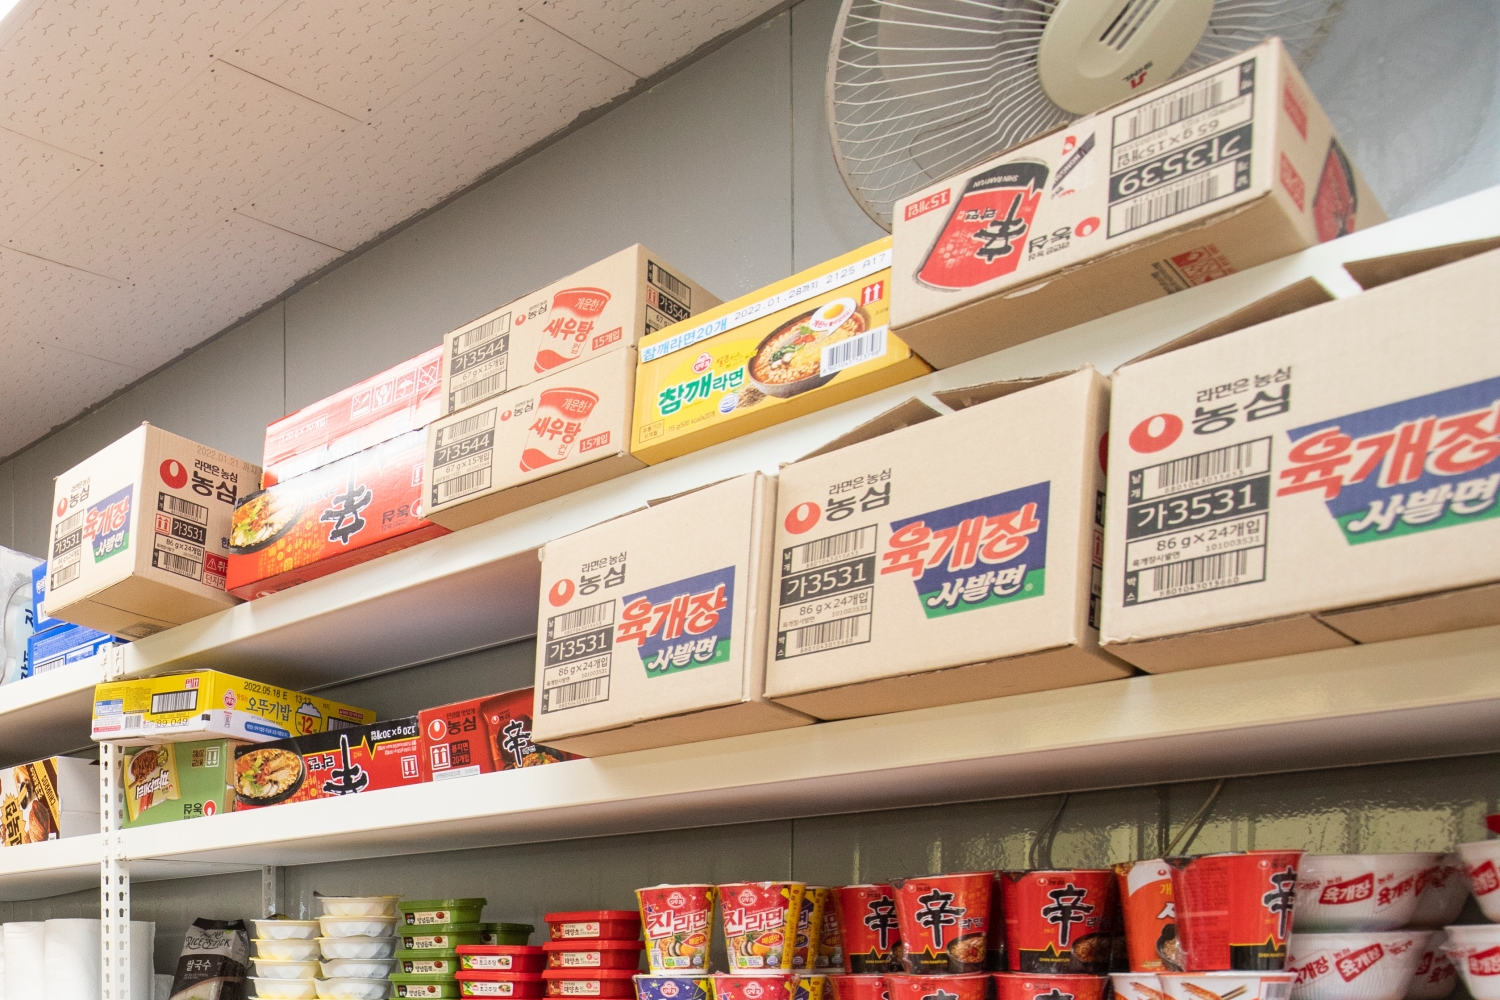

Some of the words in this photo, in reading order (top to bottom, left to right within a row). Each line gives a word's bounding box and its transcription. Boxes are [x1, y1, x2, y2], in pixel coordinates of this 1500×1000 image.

[1119, 134, 1240, 193] 가3539
[826, 264, 855, 284] 2125
[863, 252, 886, 270] A17
[545, 316, 594, 342] 새우탕
[593, 327, 622, 349] 15개입
[455, 339, 505, 369] 가3544
[658, 367, 744, 415] 참깨라면
[1196, 378, 1251, 403] 라면은
[1192, 383, 1291, 435] 농심
[531, 416, 582, 444] 새우탕
[581, 432, 610, 452] 15개입
[439, 433, 489, 464] 가3544
[192, 471, 237, 505] 농심
[1137, 484, 1257, 529] 가3531
[880, 503, 1040, 578] 육개장
[1156, 539, 1177, 552] 86
[786, 563, 870, 597] 가3531
[927, 563, 1027, 608] 사발면
[616, 585, 727, 647] 육개장
[648, 635, 715, 671] 사발면
[244, 681, 282, 698] 2022.05.18
[246, 696, 292, 719] 오뚜기밥
[301, 716, 314, 733] 12
[451, 743, 470, 755] 봉지면
[647, 908, 708, 940] 진라면
[724, 907, 784, 938] 진라면
